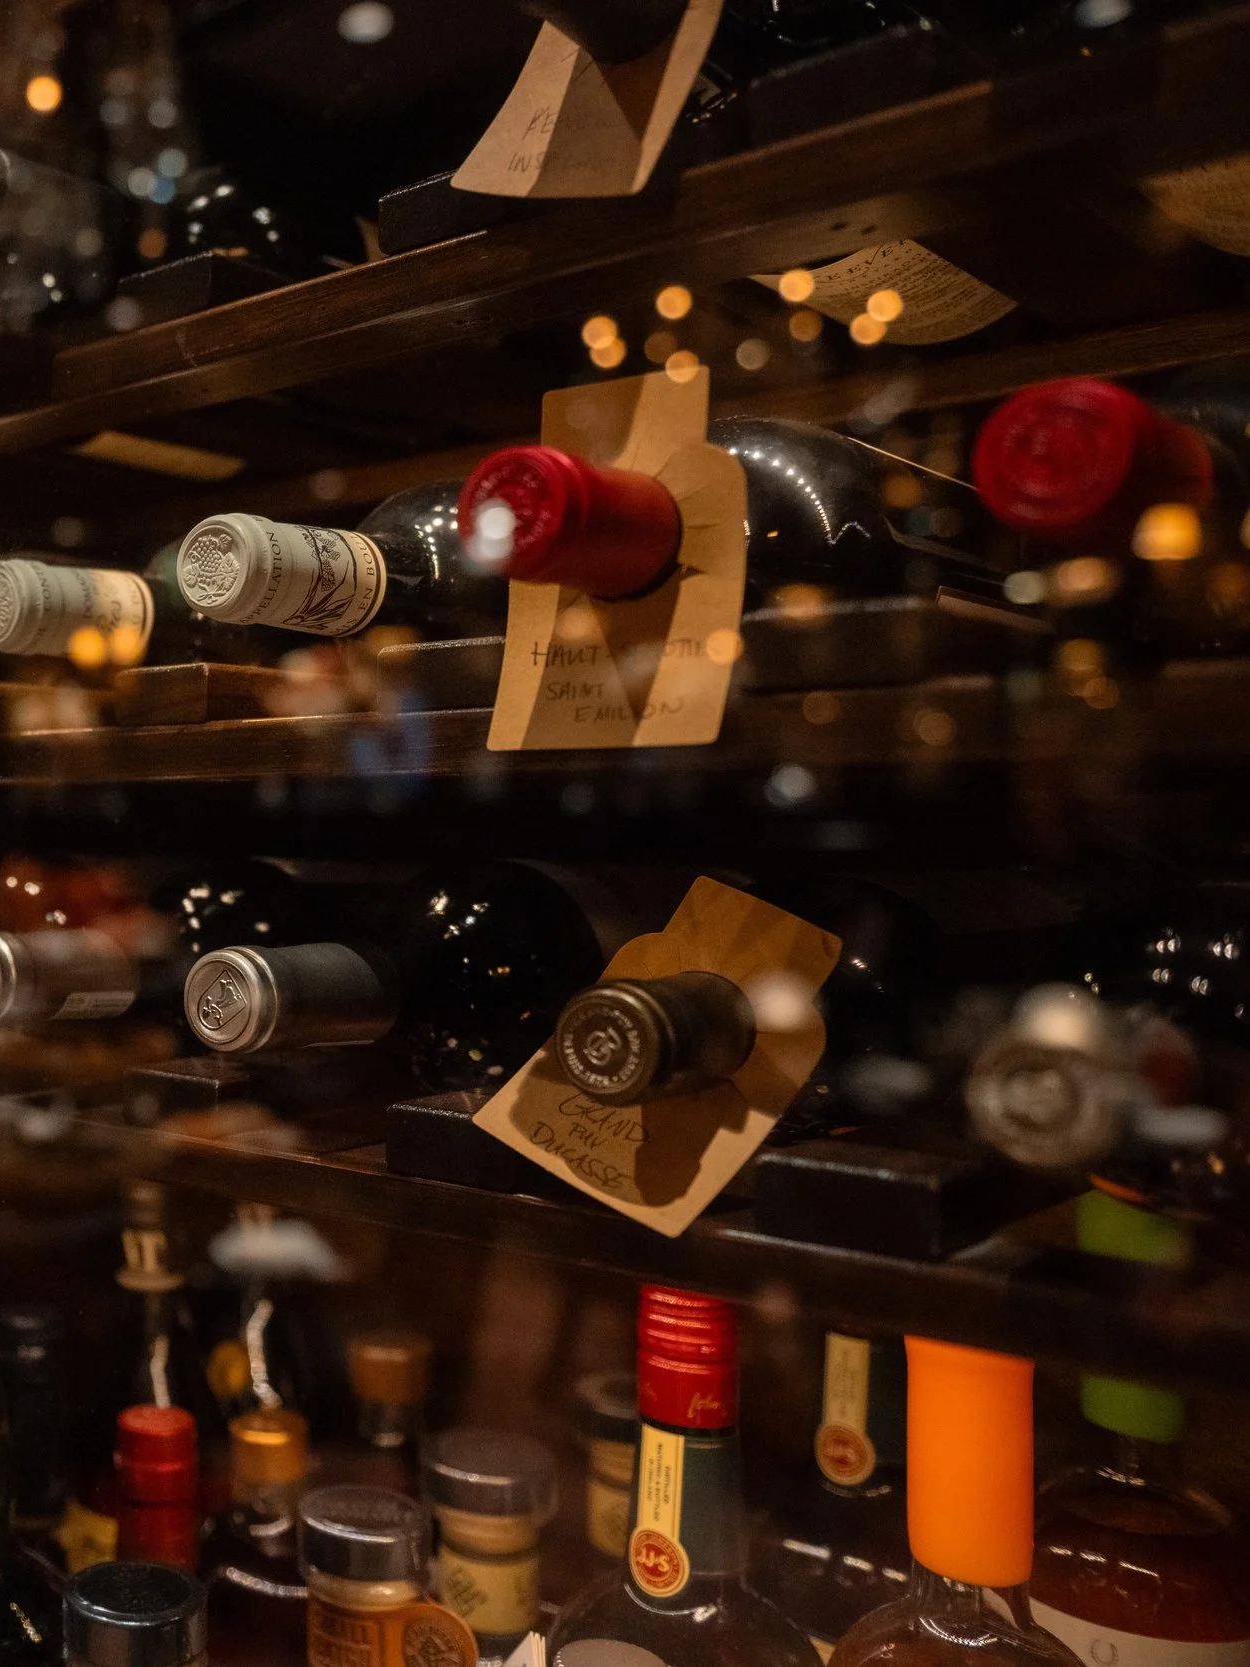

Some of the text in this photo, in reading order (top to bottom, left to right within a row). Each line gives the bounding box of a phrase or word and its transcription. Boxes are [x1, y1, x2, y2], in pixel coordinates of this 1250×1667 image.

[239, 531, 282, 625] APPELLATION
[359, 586, 374, 611] EN
[546, 681, 605, 702] SAINT
